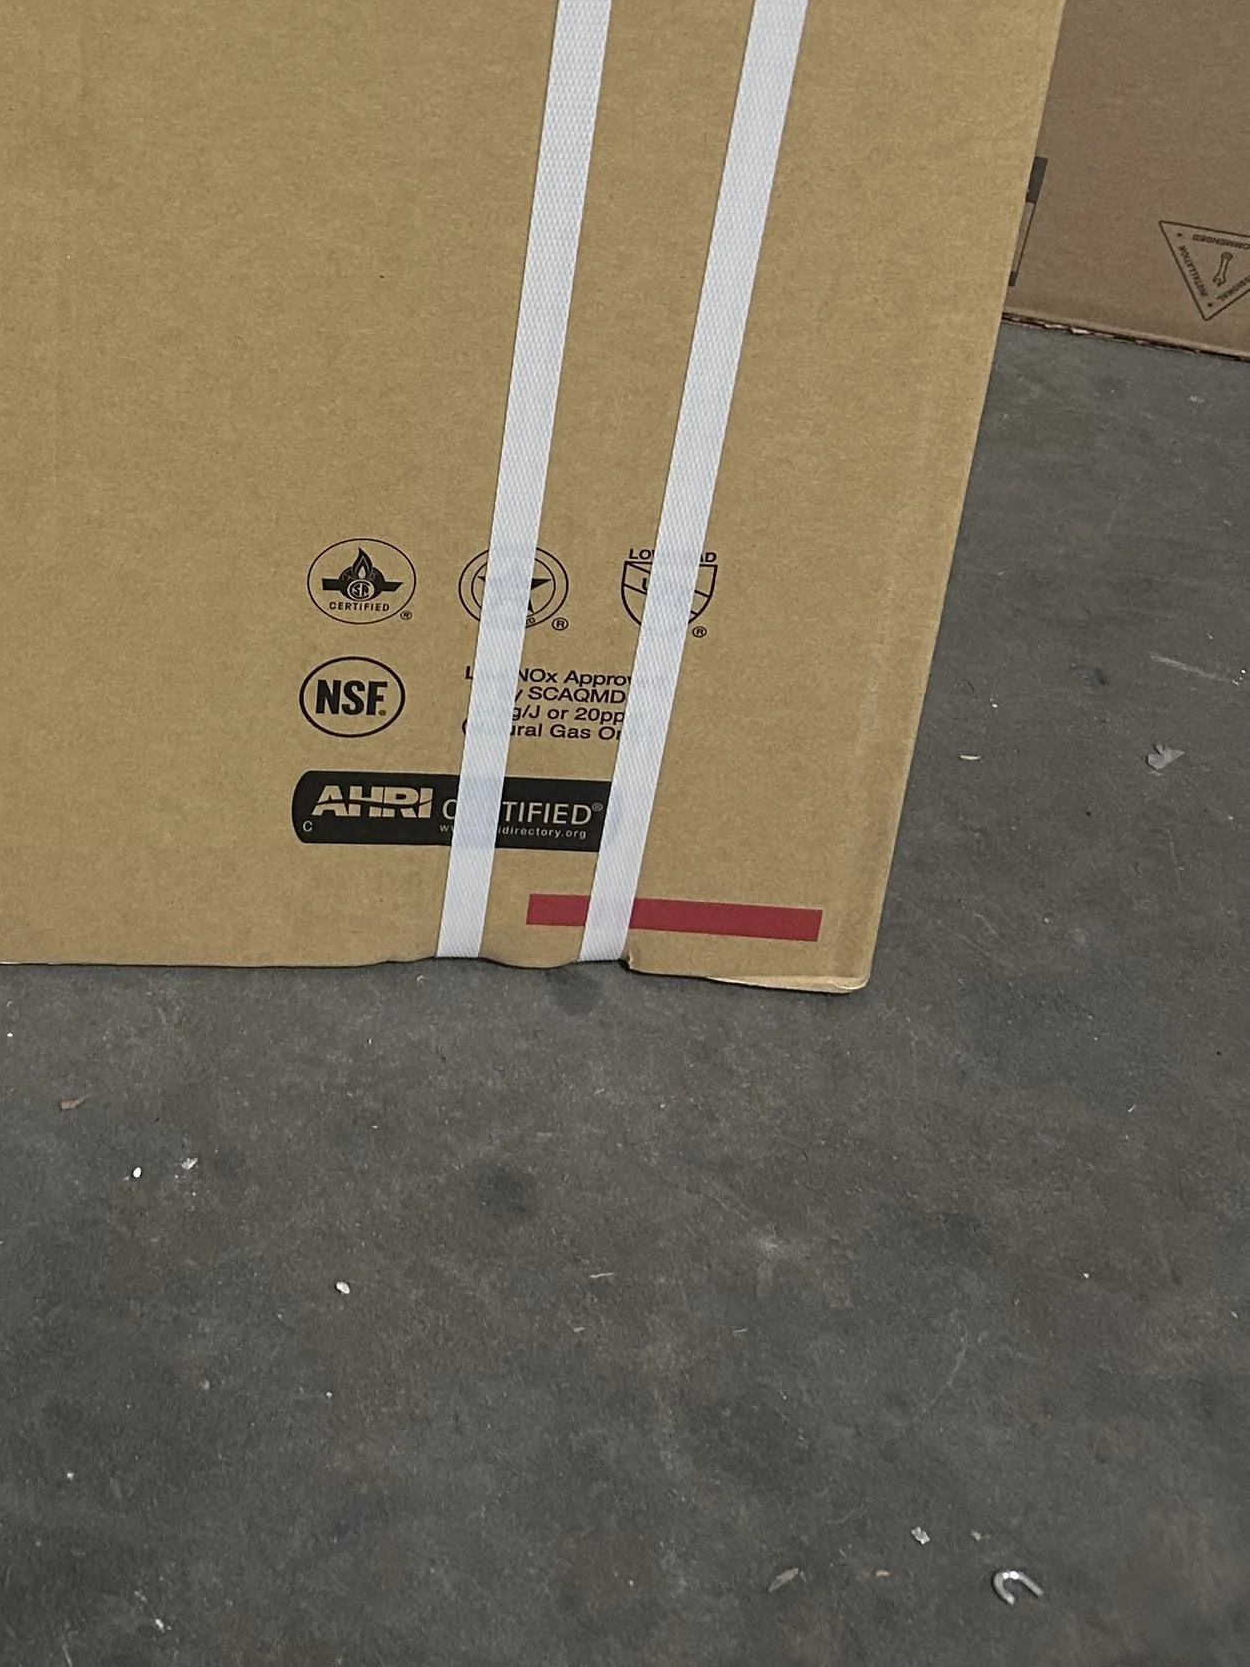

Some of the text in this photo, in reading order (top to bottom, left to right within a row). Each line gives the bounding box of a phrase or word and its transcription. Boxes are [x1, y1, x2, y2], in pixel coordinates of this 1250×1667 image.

[329, 601, 390, 613] CERTIFIED
[528, 686, 626, 704] SCAQMD
[547, 708, 569, 720] or
[550, 724, 591, 739] Gas
[311, 784, 434, 819] AHRI
